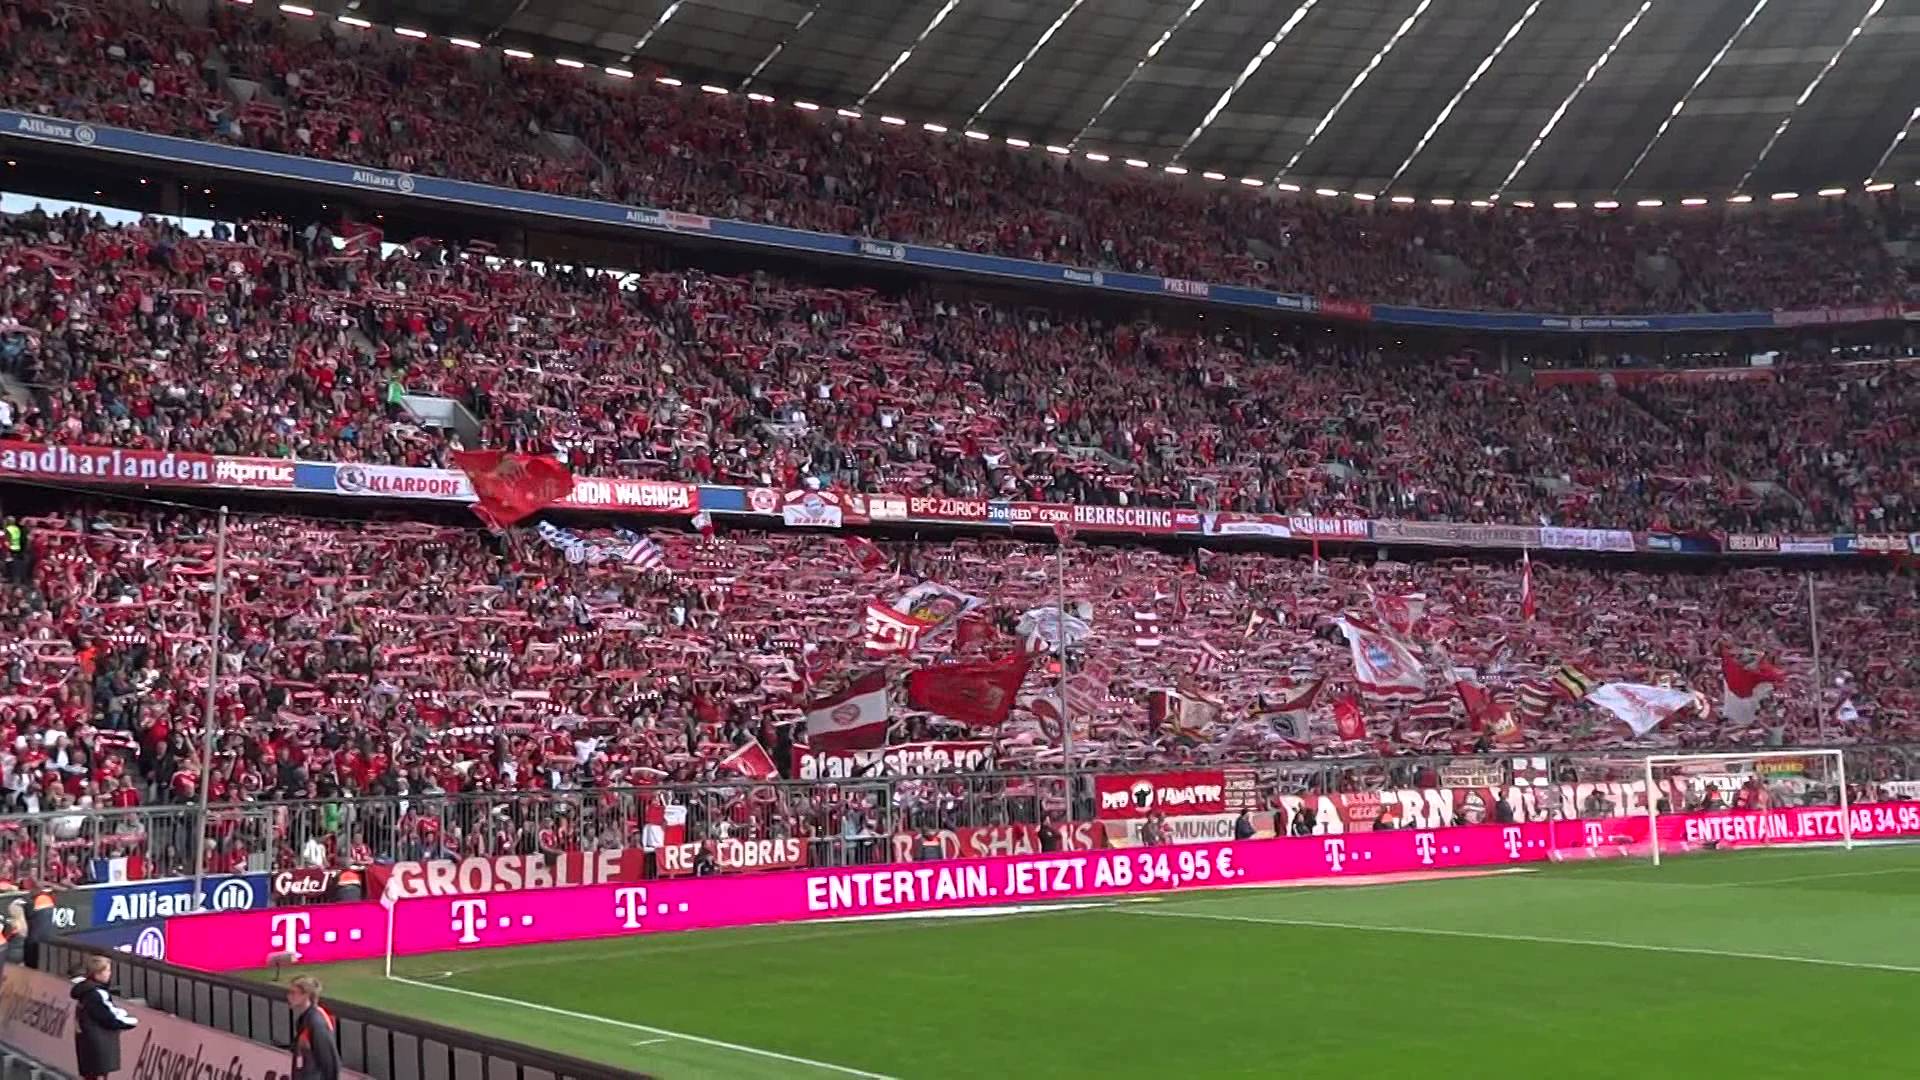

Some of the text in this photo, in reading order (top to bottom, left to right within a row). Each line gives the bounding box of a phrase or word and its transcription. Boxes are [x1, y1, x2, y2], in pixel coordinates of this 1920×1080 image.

[18, 118, 72, 139] Allianz
[353, 170, 395, 187] Allianz
[626, 210, 660, 225] Allian
[368, 474, 461, 496] KLARDORF
[911, 497, 938, 513] BFC
[1073, 504, 1172, 528] HERRSCHING
[1685, 812, 1794, 842] ENTERTAIN.
[1851, 809, 1873, 833] AB
[717, 837, 801, 868] COBRAS
[971, 823, 1093, 858] SHAKS
[806, 864, 997, 912] ENTERTAIN.
[1004, 857, 1087, 897] JETZT
[1094, 855, 1132, 888] AB
[1137, 850, 1210, 889] 34,95
[107, 891, 206, 923] Allianz
